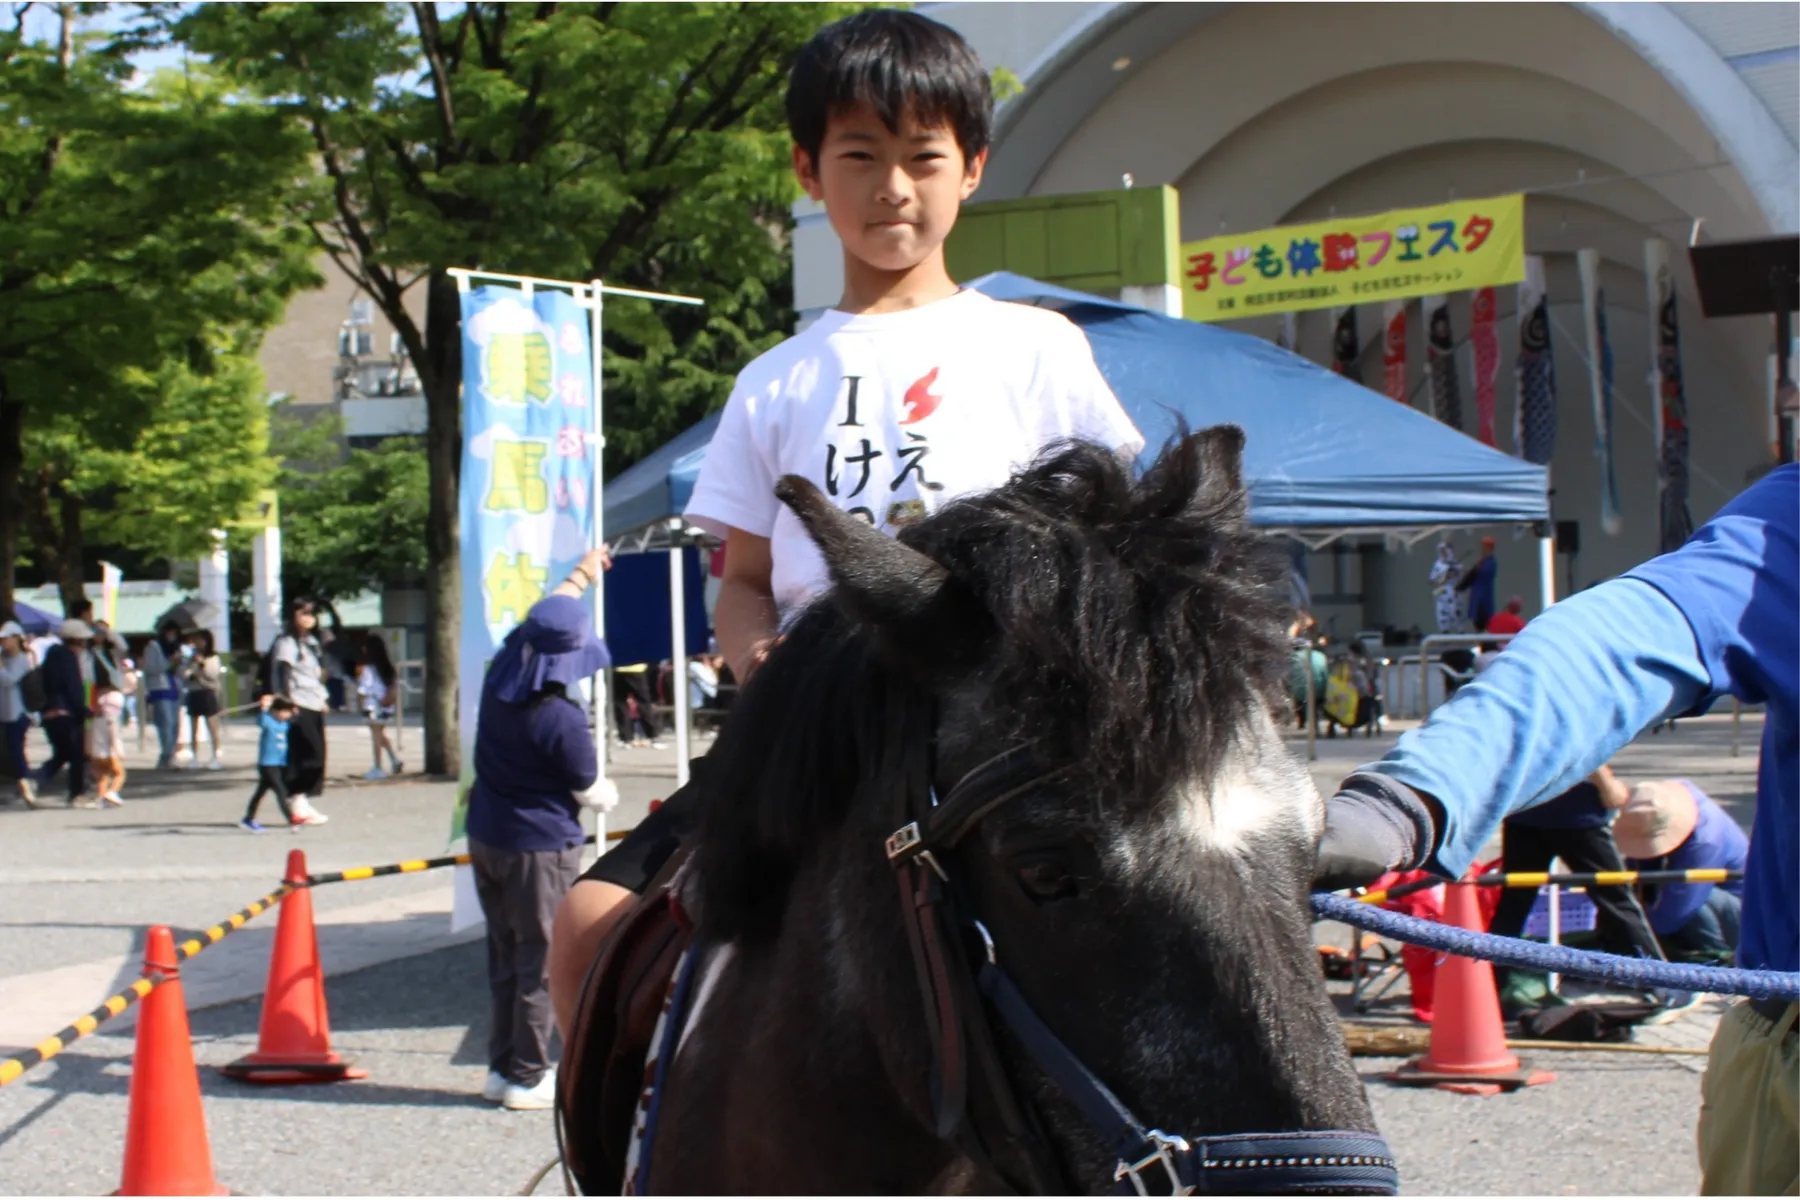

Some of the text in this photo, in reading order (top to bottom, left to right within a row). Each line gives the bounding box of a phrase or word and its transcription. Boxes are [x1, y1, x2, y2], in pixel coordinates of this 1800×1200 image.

[1186, 215, 1494, 292] 子ども体験フェスタ
[837, 375, 866, 427] I
